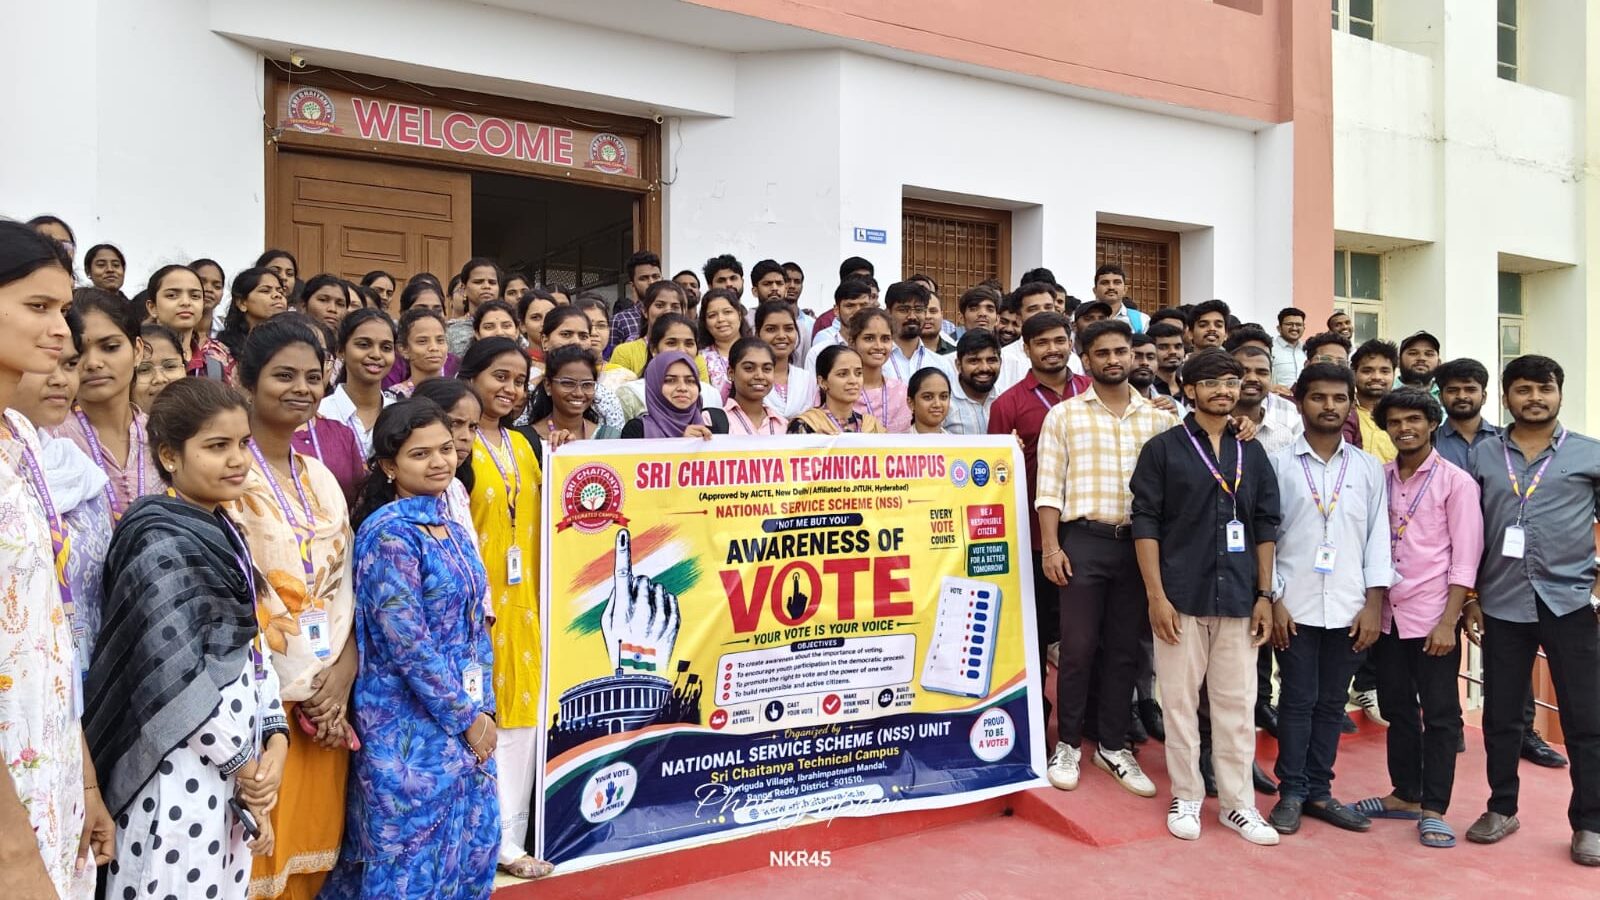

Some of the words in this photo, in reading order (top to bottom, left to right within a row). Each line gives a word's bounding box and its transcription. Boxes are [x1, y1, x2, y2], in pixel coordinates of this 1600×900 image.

[352, 97, 574, 166] WELCOME
[636, 462, 671, 489] SRI
[678, 458, 785, 487] CHAITANYA
[790, 455, 880, 482] TECHNICAL
[885, 454, 946, 479] CAMPUS
[974, 467, 986, 475] ISO
[565, 480, 577, 499] SRI
[576, 468, 620, 496] CHAITANYA
[698, 490, 738, 502] (Approved
[740, 490, 750, 500] by
[751, 489, 774, 498] AICTE,
[776, 489, 790, 497] New
[813, 485, 841, 494] Affiliated
[843, 485, 851, 493] to
[875, 483, 909, 493] Hyderabad)
[716, 503, 777, 519] NATIONAL
[781, 499, 825, 515] SERVICE
[828, 497, 873, 511] SCHEME
[876, 495, 903, 511] (NSS)
[930, 508, 952, 519] EVERY
[796, 518, 809, 527] ME
[810, 517, 827, 526] BUT
[930, 520, 954, 533] VOTE
[970, 516, 1003, 527] RESPONSIBLE
[977, 527, 997, 536] CITIZEN
[726, 530, 870, 565] AWARENESS
[877, 527, 905, 552] OF
[930, 535, 956, 545] COUNTS
[973, 546, 985, 555] VOTE
[986, 545, 1003, 554] TODAY
[970, 556, 980, 565] FOR
[981, 555, 986, 563] A
[986, 554, 1006, 563] BETTER
[973, 563, 1004, 574] TOMORROW
[719, 555, 914, 634] VOTE
[949, 587, 963, 595] VOTE
[753, 630, 781, 646] YOUR
[784, 626, 811, 641] VOTE
[815, 624, 825, 636] IS
[829, 621, 858, 635] YOUR
[862, 619, 894, 632] VOICE
[797, 639, 838, 650] OBJECTIVES
[765, 656, 794, 665] awareness
[795, 652, 811, 660] about
[745, 668, 775, 677] encourage
[776, 665, 793, 674] youth
[794, 660, 830, 670] participation
[849, 656, 881, 664] democratic
[743, 678, 768, 688] promote
[780, 674, 794, 682] right
[840, 667, 859, 675] power
[759, 684, 792, 694] responsible
[983, 715, 1005, 728] PROUD
[784, 722, 829, 740] Organized
[831, 723, 841, 736] by
[984, 728, 993, 738] TO
[995, 727, 1004, 737] BE
[661, 750, 745, 778] NATIONAL
[749, 739, 811, 763] SERVICE
[816, 731, 873, 753] SCHEME
[877, 725, 915, 746] (NSS)
[918, 721, 952, 739] UNIT
[978, 740, 985, 748] A
[986, 738, 1009, 748] VOTER
[710, 769, 729, 784] Sri
[732, 759, 794, 781] Chaitanya
[798, 753, 853, 770] Technical
[855, 746, 900, 762] Campus
[595, 772, 611, 784] YOUR
[613, 768, 631, 778] VOTE
[766, 775, 796, 787] Village,
[797, 766, 855, 782] Ibrahimpatnam
[774, 785, 799, 799] Reddy
[800, 781, 829, 793] District
[606, 800, 625, 811] POWER
